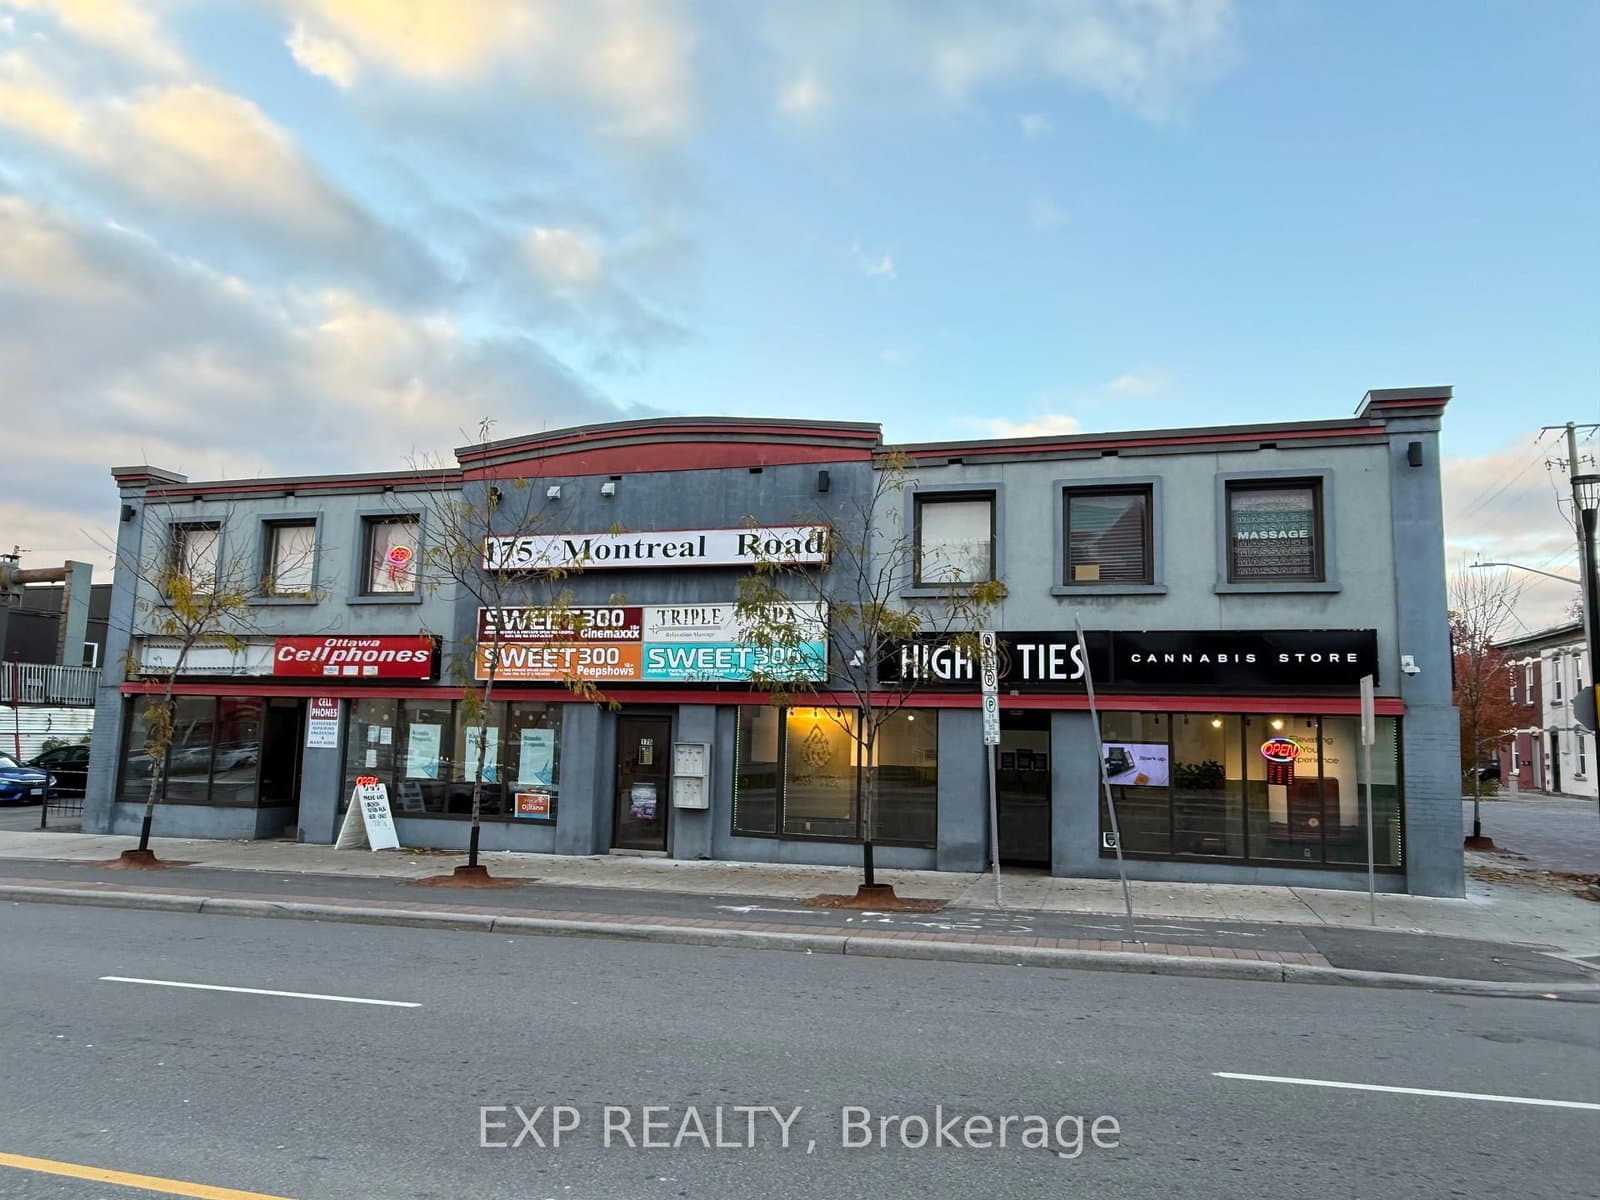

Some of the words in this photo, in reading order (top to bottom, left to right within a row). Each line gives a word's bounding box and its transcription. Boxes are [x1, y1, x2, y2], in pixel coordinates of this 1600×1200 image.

[1237, 530, 1309, 540] MASSAGE
[487, 540, 533, 563] 175
[562, 535, 706, 562] Montreal
[737, 531, 824, 557] Road
[657, 608, 722, 626] TRIPLE
[580, 628, 640, 639] Cinemaxxx
[324, 638, 381, 647] Ottawa
[901, 643, 974, 680] HIGH
[1016, 643, 1086, 680] TIES
[1131, 653, 1257, 663] CANNABIS
[1279, 653, 1358, 663] STORE
[577, 665, 635, 678] Peepshows
[318, 698, 333, 707] CELL
[311, 708, 338, 718] PHONES
[1264, 743, 1299, 759] OPEN
